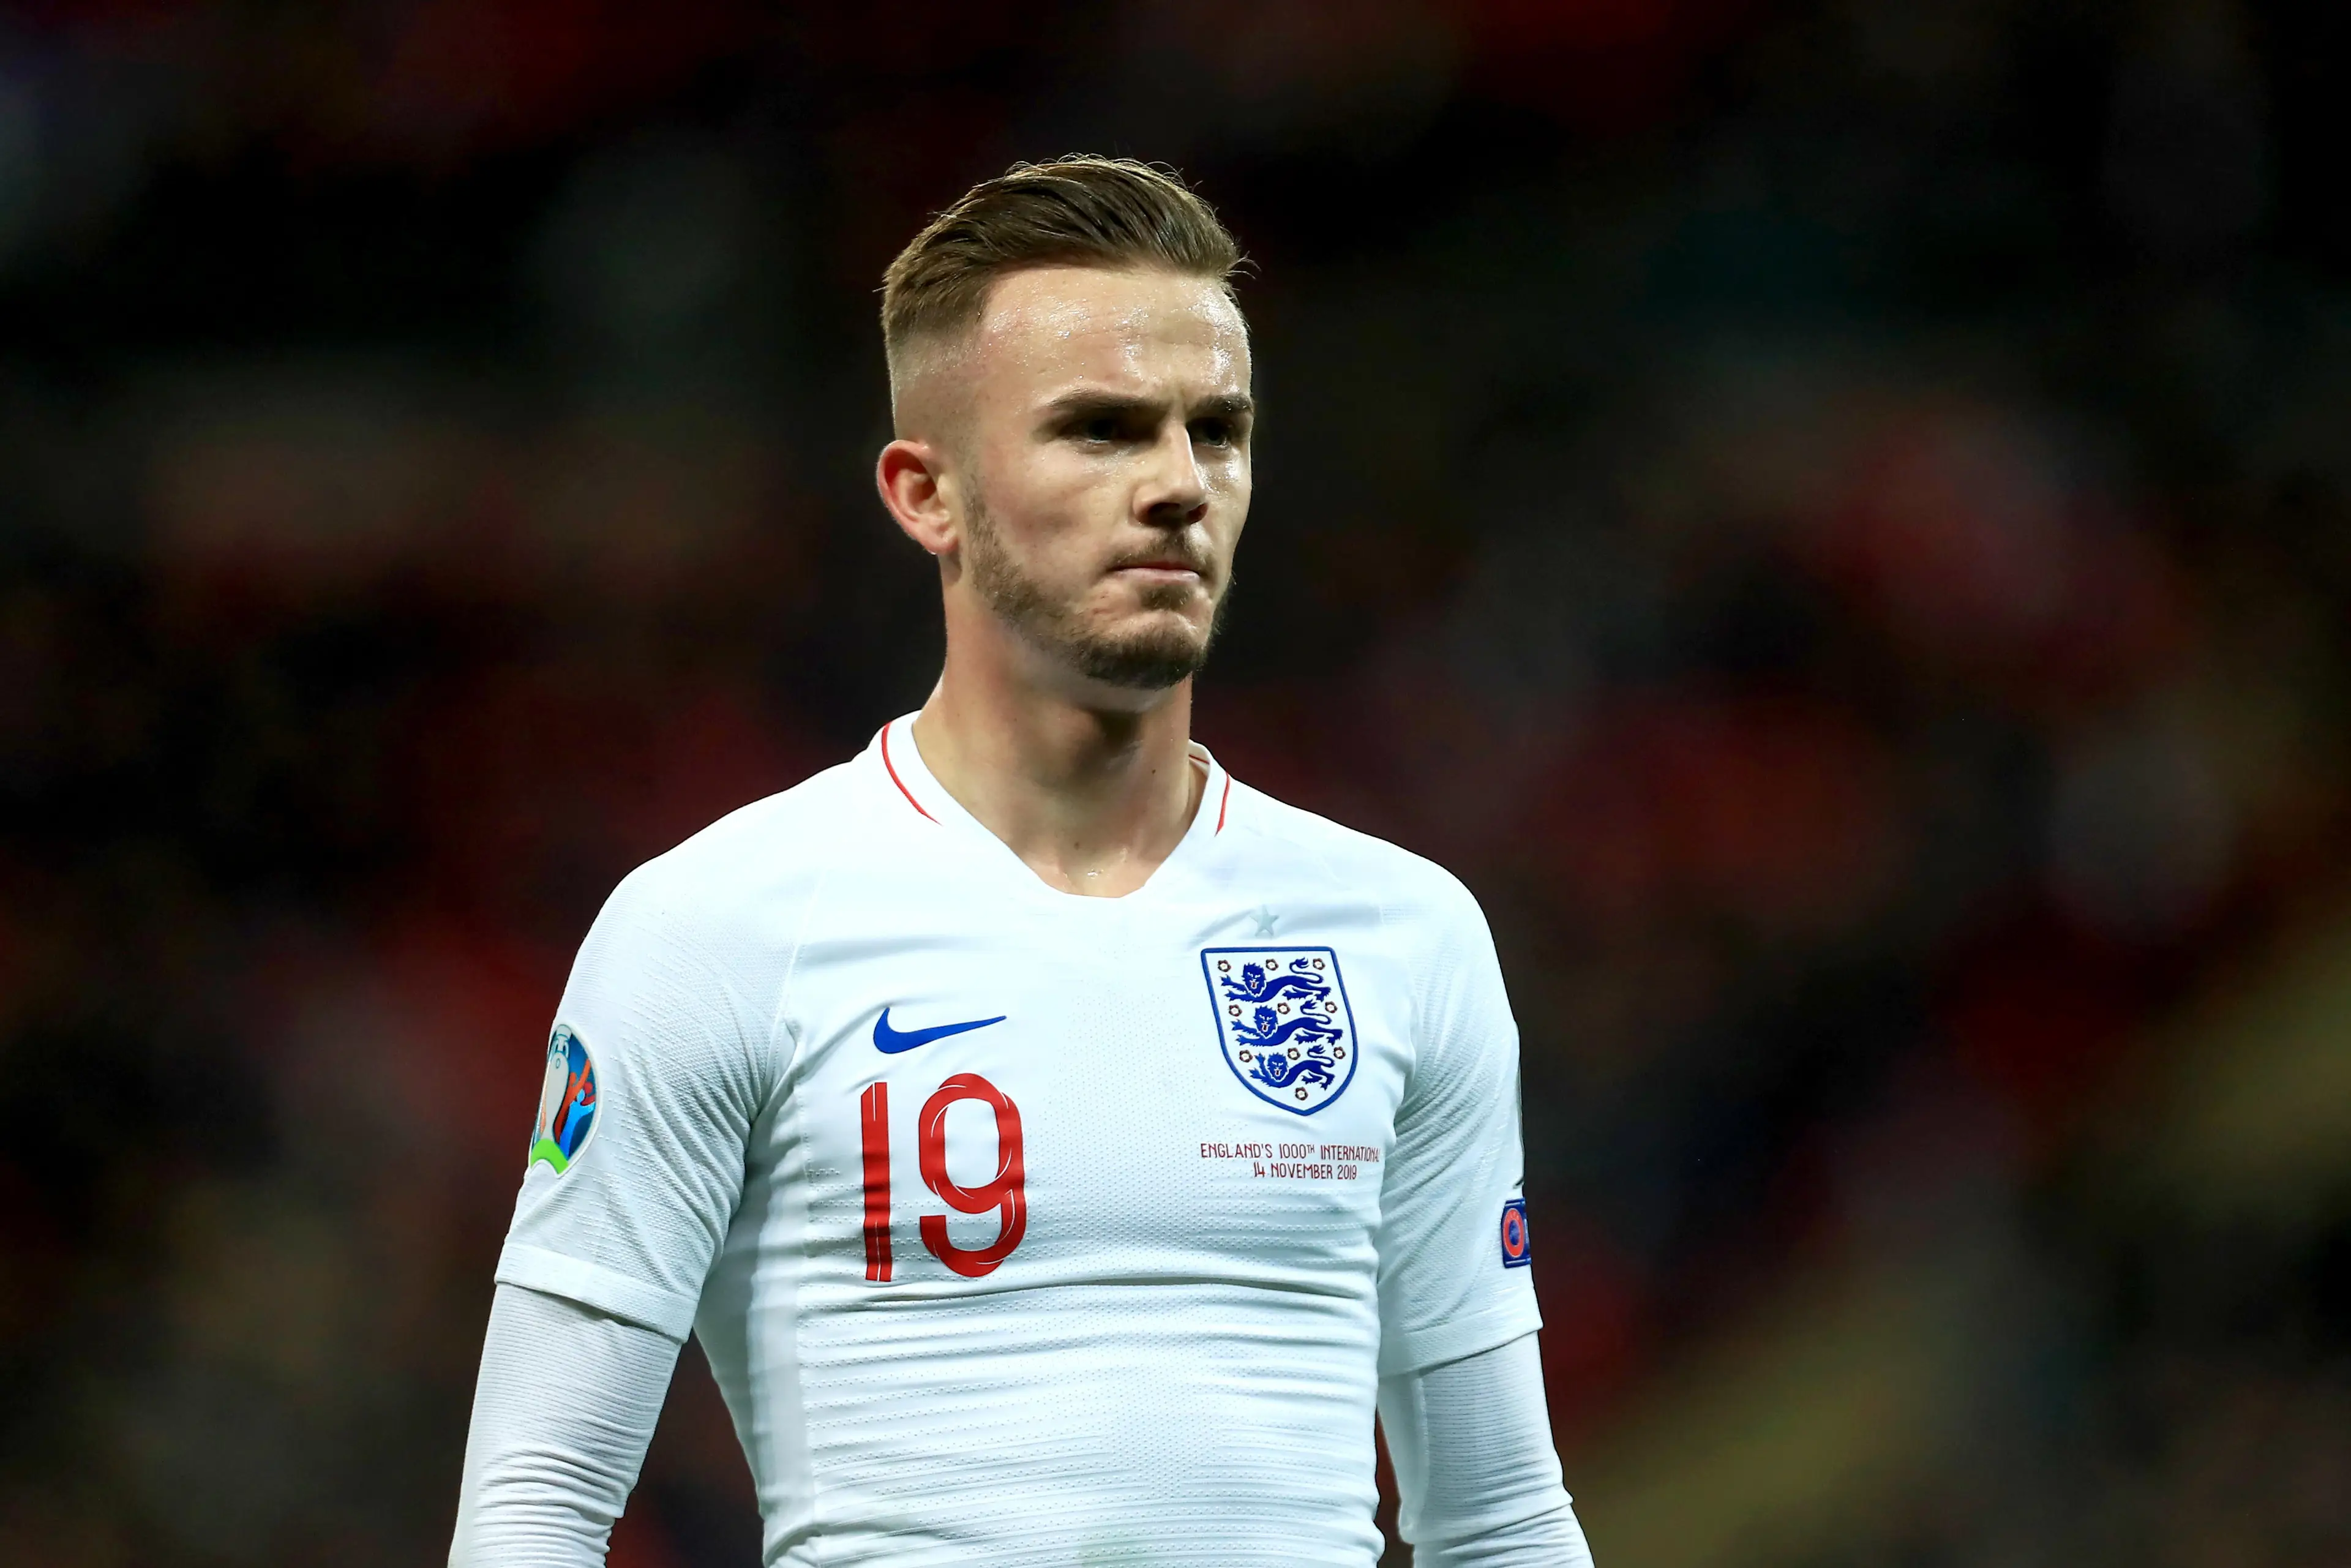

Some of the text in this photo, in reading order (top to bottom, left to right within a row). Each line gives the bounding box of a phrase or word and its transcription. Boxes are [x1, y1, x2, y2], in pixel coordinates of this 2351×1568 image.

[1201, 1143, 1273, 1158] ENGLAND'S
[1279, 1144, 1315, 1159] 1000TH
[861, 1073, 1026, 1281] 19
[1254, 1162, 1357, 1180] 14 NOVEMBER 2019
